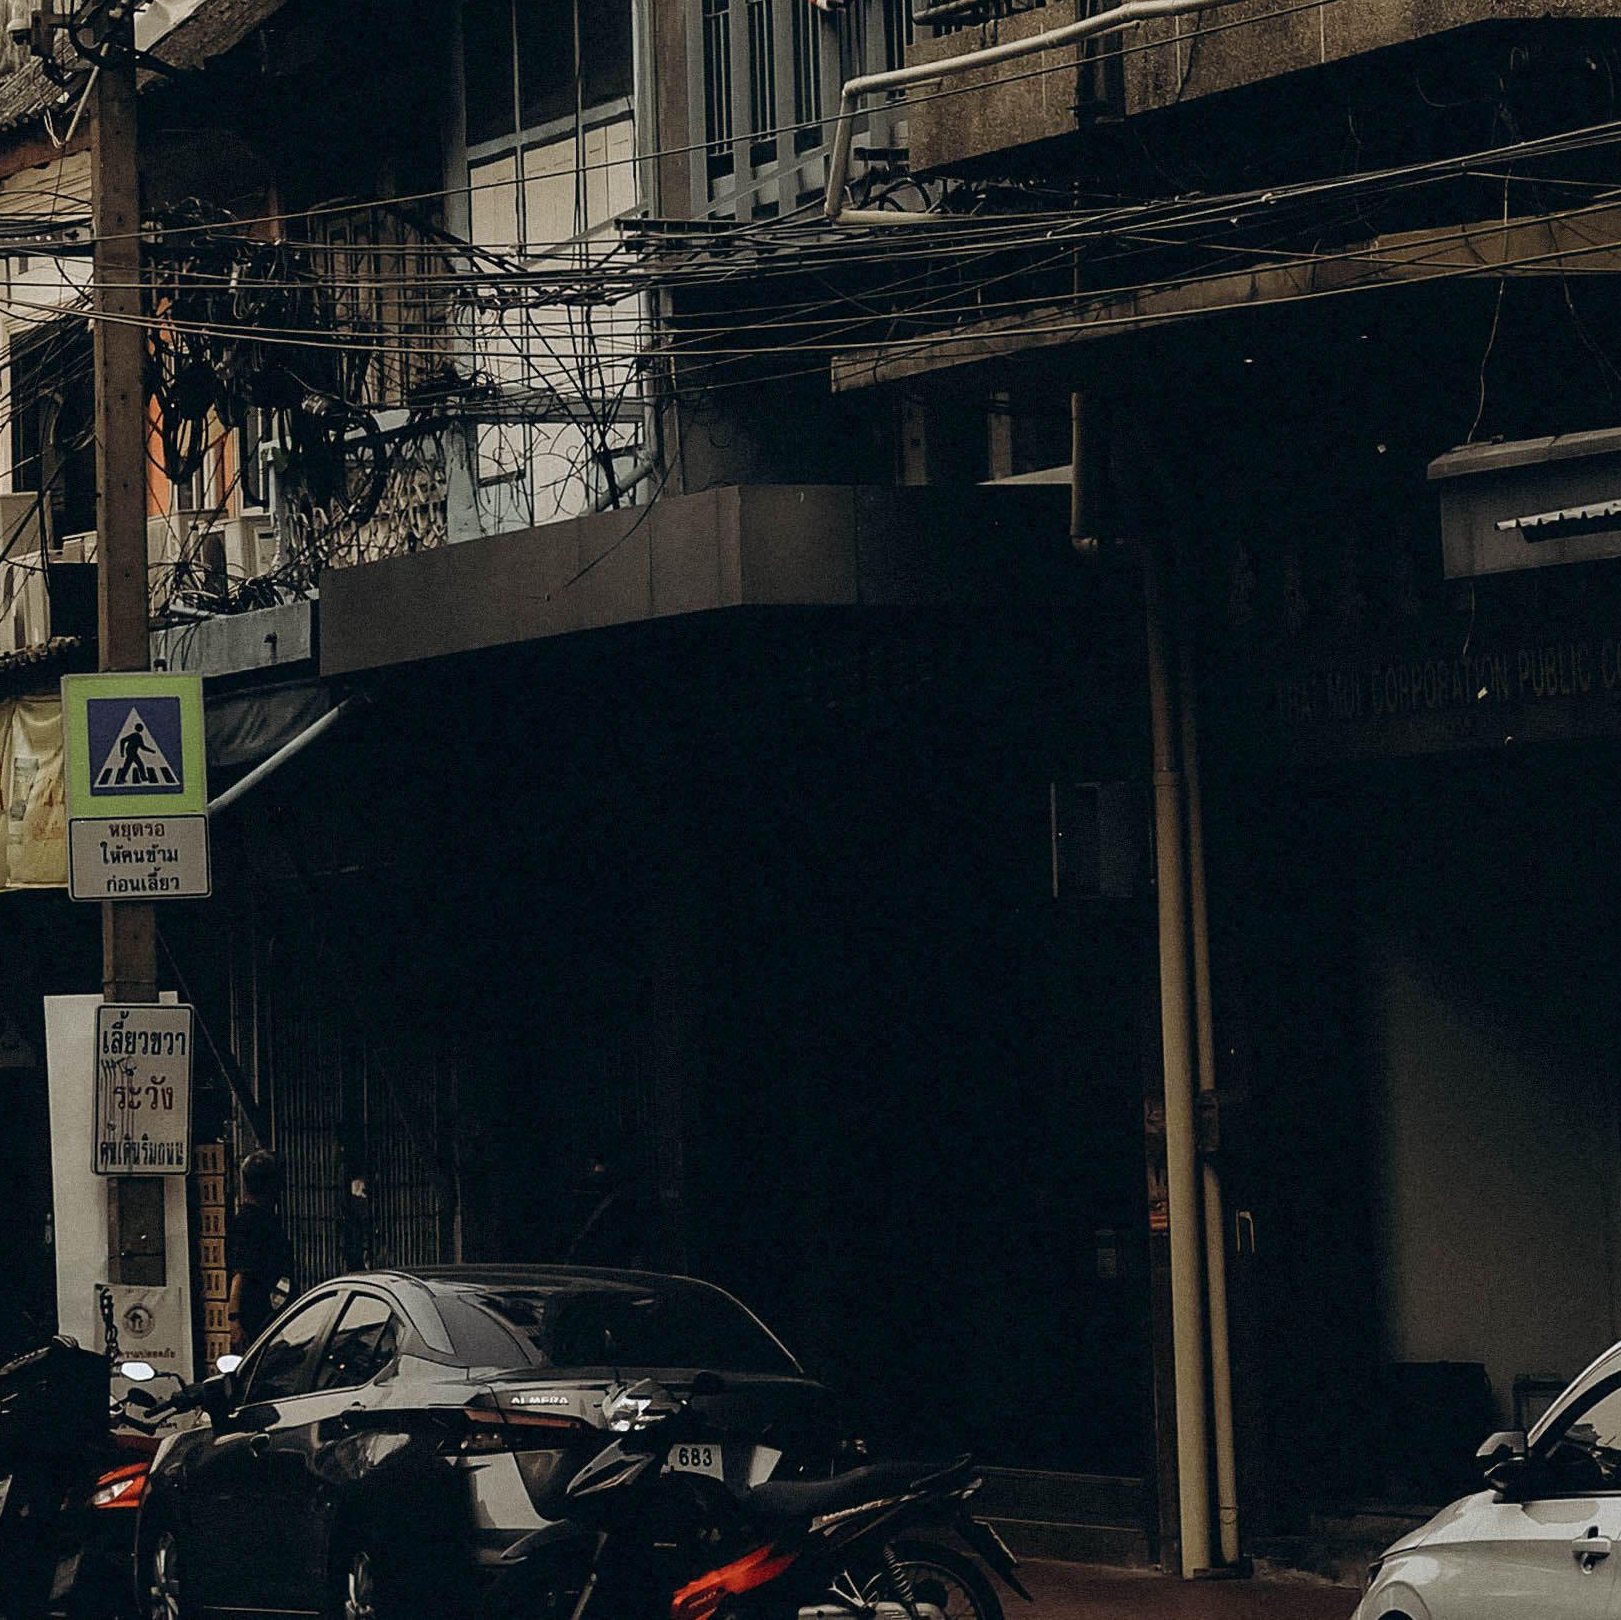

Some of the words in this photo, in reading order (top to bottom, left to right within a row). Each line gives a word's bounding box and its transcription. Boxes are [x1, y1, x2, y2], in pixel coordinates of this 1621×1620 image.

[108, 822, 165, 841] หยุดรอ
[100, 841, 179, 864] ให้คนข้าม
[106, 866, 180, 893] ก่อนเลี้ยว
[102, 1010, 187, 1055] เลี้ยวขวา
[113, 1075, 174, 1110] ระวัง
